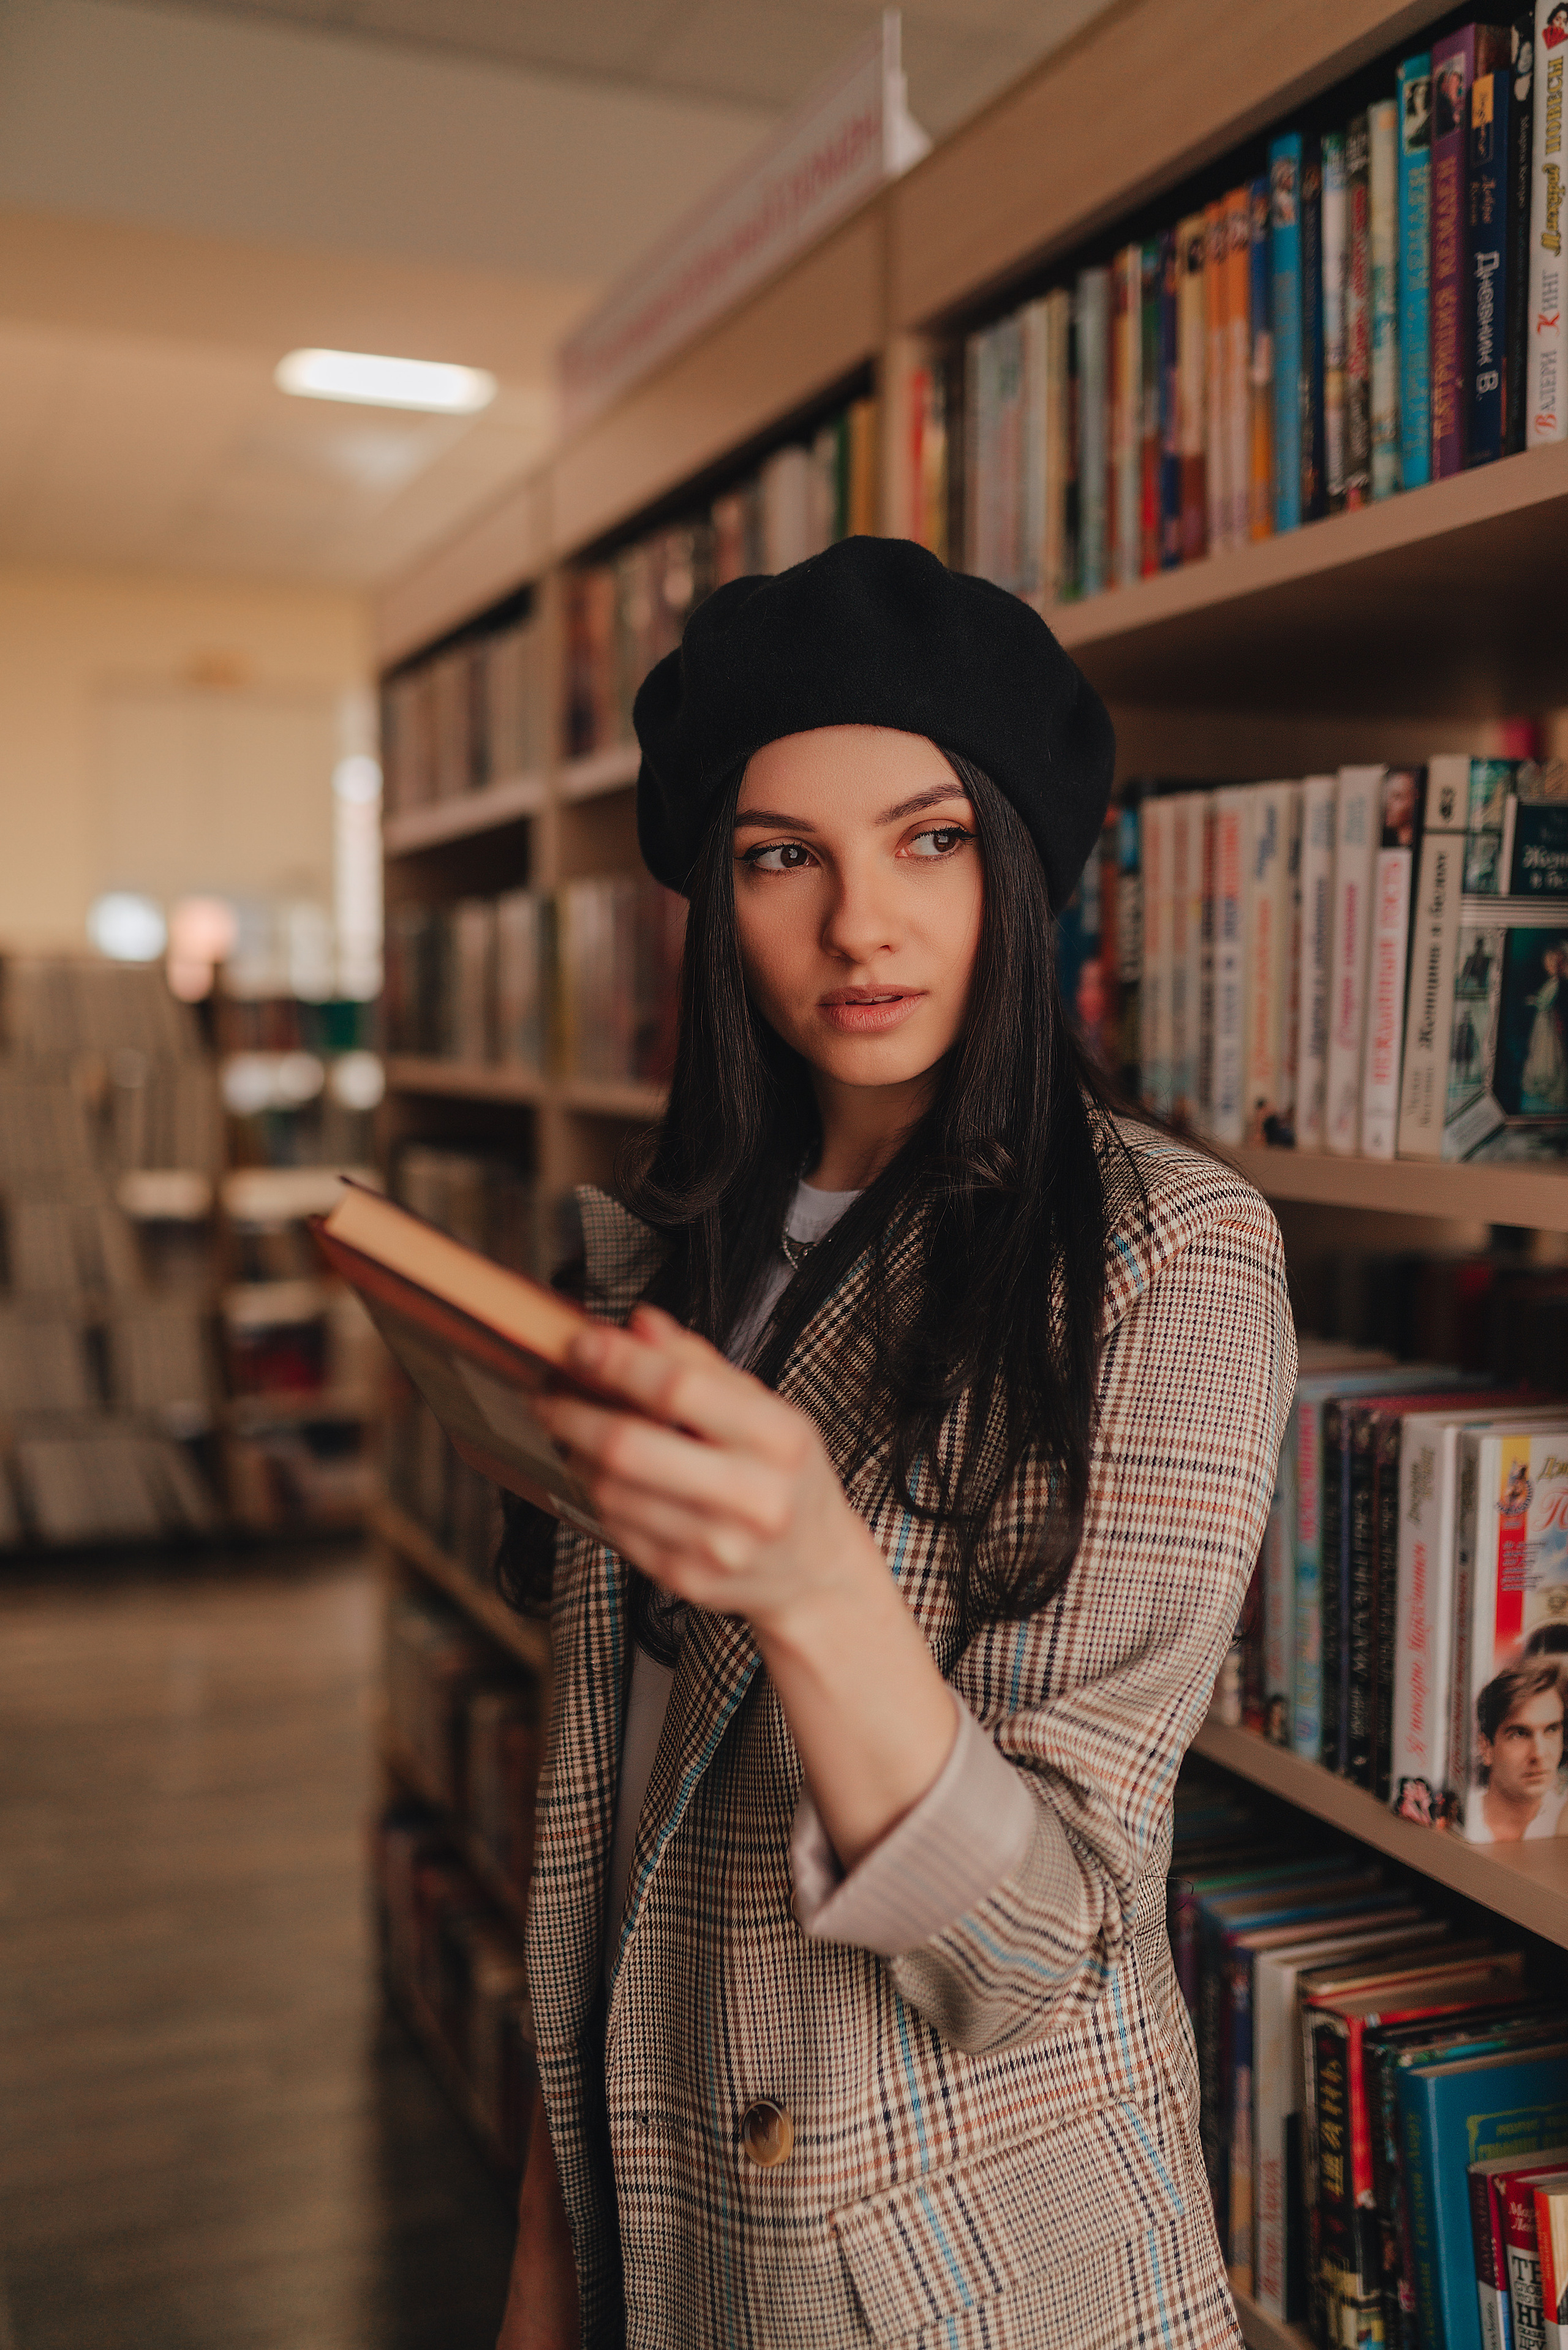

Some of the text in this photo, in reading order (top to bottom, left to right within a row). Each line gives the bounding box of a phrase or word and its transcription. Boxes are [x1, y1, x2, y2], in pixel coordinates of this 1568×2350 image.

[1545, 56, 1564, 156] ПОВЕСЫ
[1474, 250, 1499, 367] Дневник
[1536, 268, 1560, 337] КИНГ
